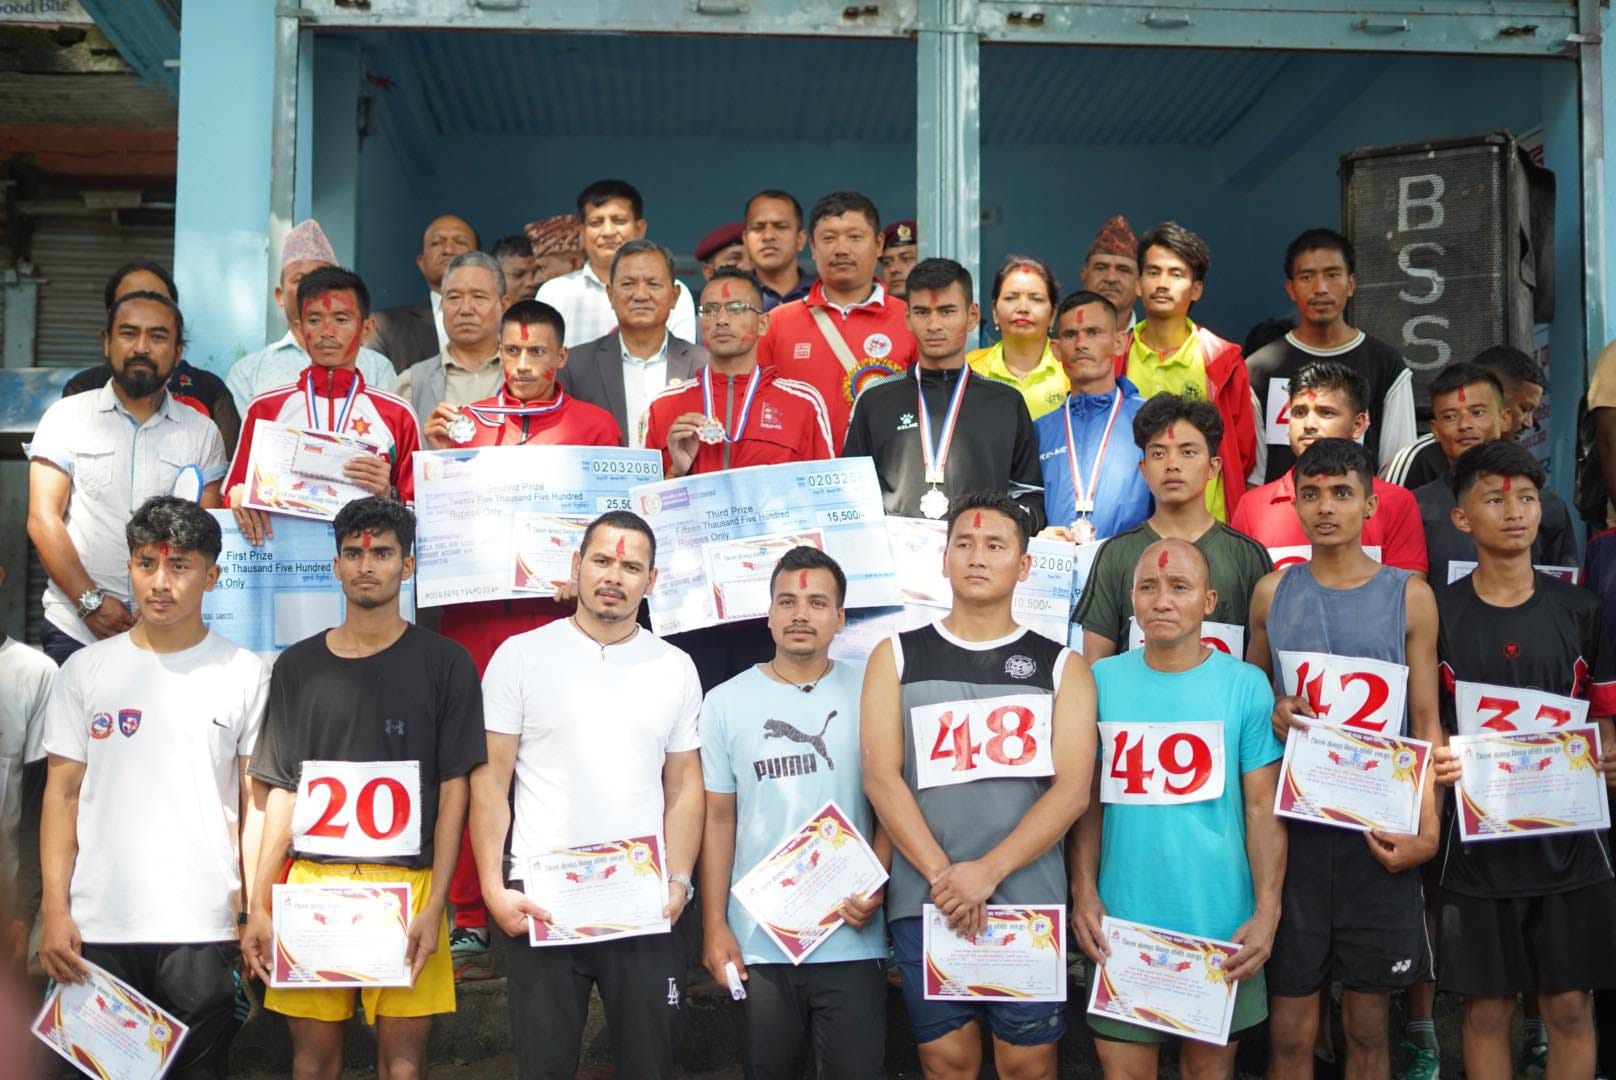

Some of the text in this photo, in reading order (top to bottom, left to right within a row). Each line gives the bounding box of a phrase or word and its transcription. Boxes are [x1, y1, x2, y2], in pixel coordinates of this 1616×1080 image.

[0, 0, 35, 14] ood
[593, 461, 658, 474] 02032080
[522, 482, 545, 491] Prize
[534, 492, 550, 501] Five
[552, 491, 583, 501] Hundred
[705, 505, 753, 520] Third Prize
[826, 510, 865, 522] 15,500/-
[703, 516, 739, 530] Thausand
[741, 514, 757, 524] Five
[759, 510, 790, 521] Hundred
[711, 531, 730, 543] Only
[226, 550, 273, 561] First Prize
[231, 563, 273, 573] Thausand
[275, 563, 293, 573] Five
[295, 562, 331, 572] Hundred
[225, 578, 245, 589] Only
[1295, 661, 1390, 732] 42
[930, 705, 1037, 772] 48
[753, 753, 818, 782] PUMA
[1110, 730, 1213, 796] 49
[304, 776, 411, 841] 20
